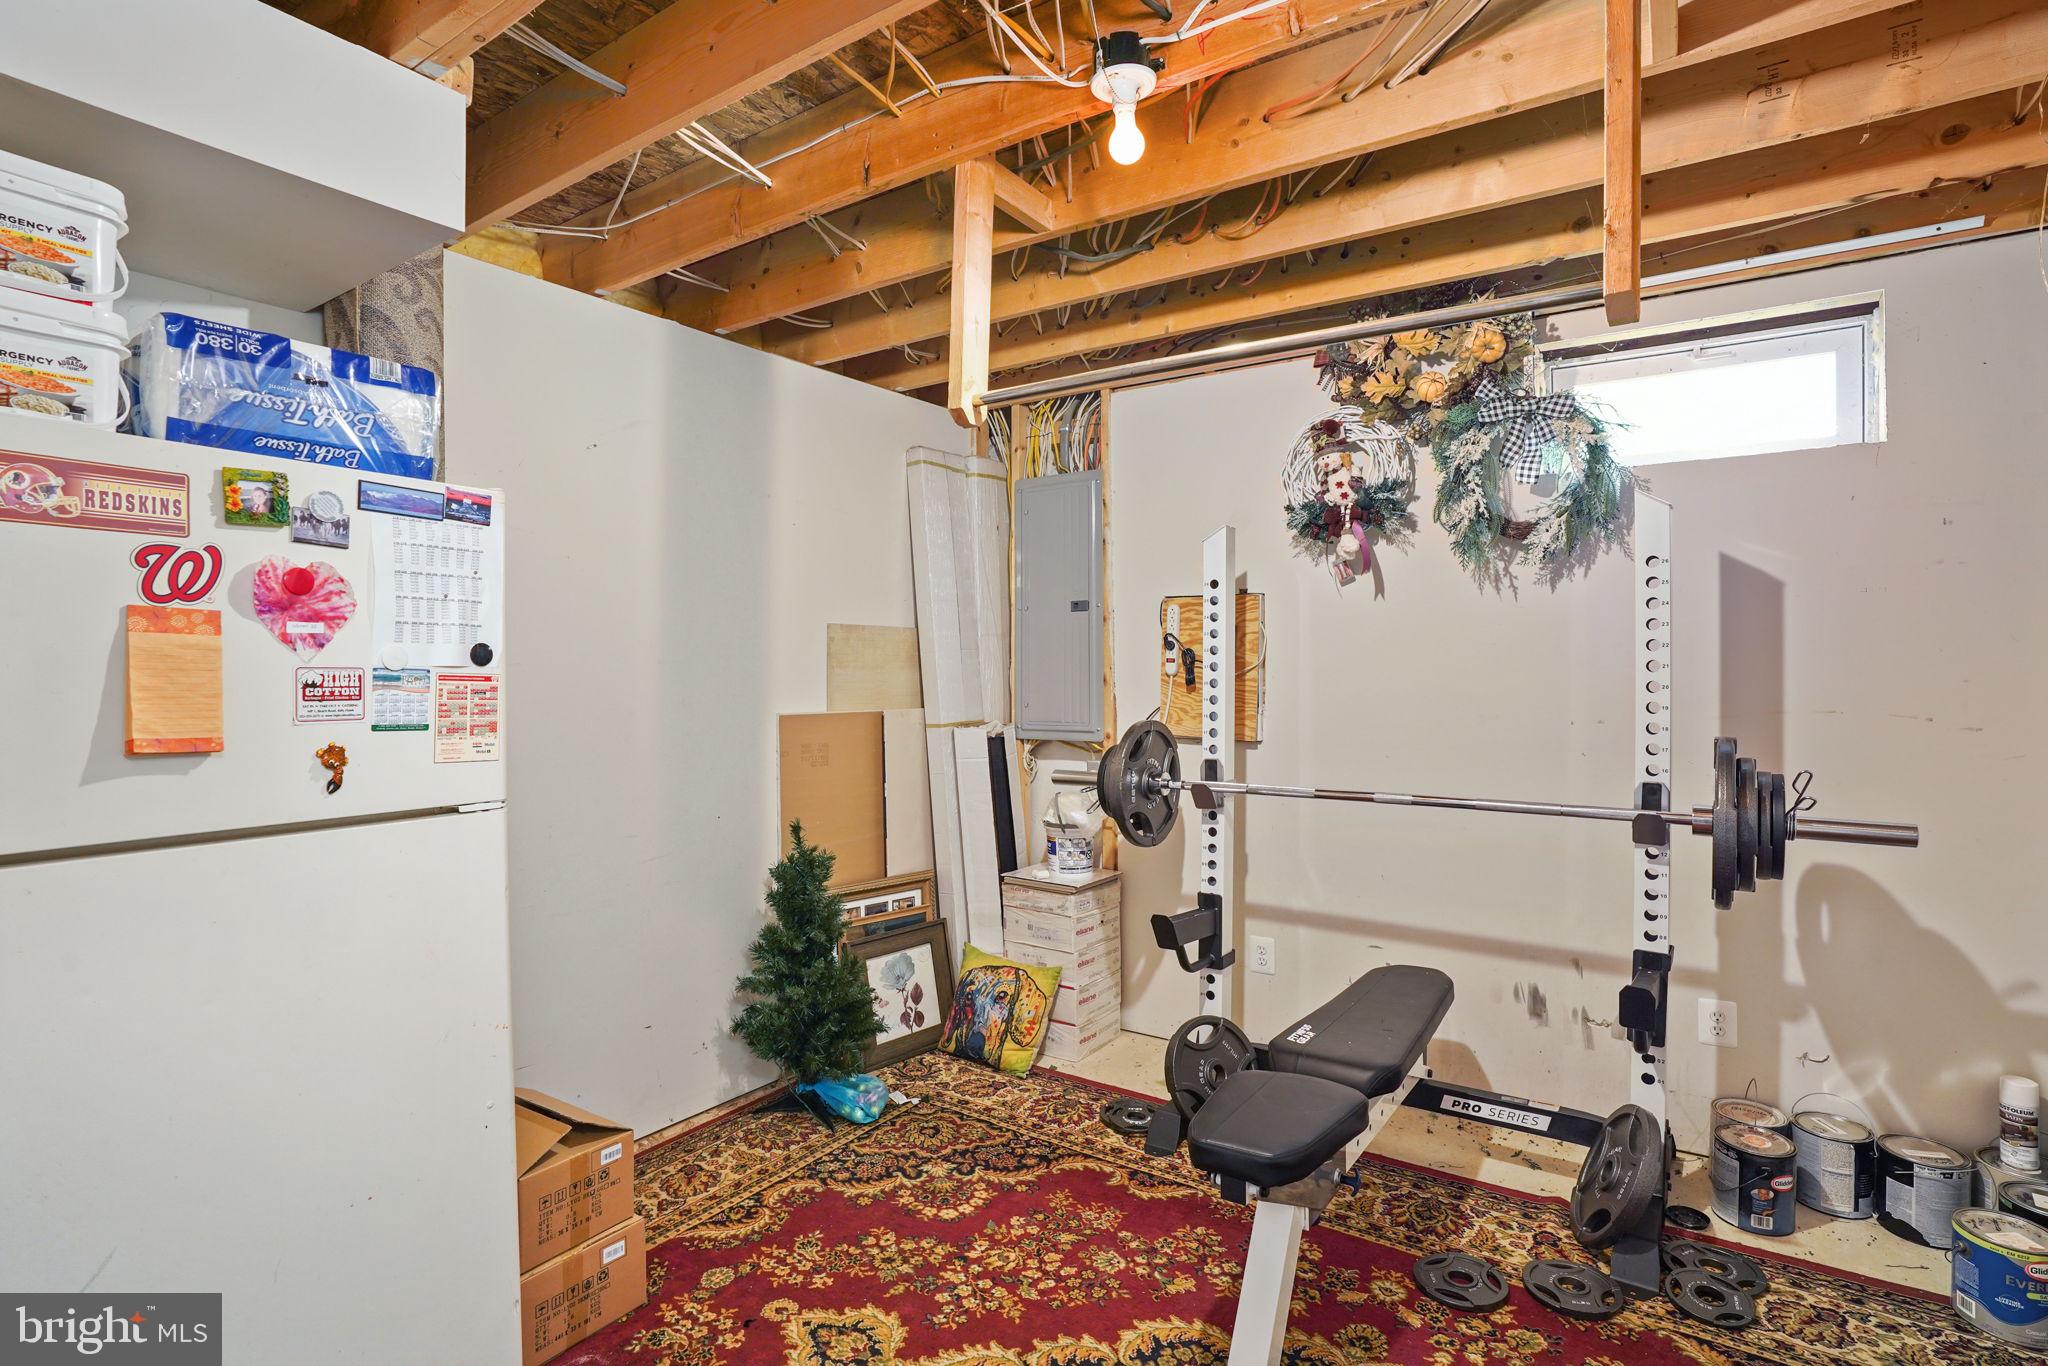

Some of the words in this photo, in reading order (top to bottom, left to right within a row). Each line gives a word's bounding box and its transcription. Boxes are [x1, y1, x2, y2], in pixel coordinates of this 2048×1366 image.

[194, 319, 234, 332] SHEETS
[195, 332, 233, 350] 380
[236, 328, 261, 339] WIDE
[239, 342, 262, 356] 30
[84, 488, 182, 517] REDSKINS
[134, 543, 222, 603] W
[323, 671, 360, 686] HIGH
[305, 687, 360, 696] COTTON
[1451, 1099, 1482, 1114] PRO
[1488, 1107, 1541, 1127] SERIES
